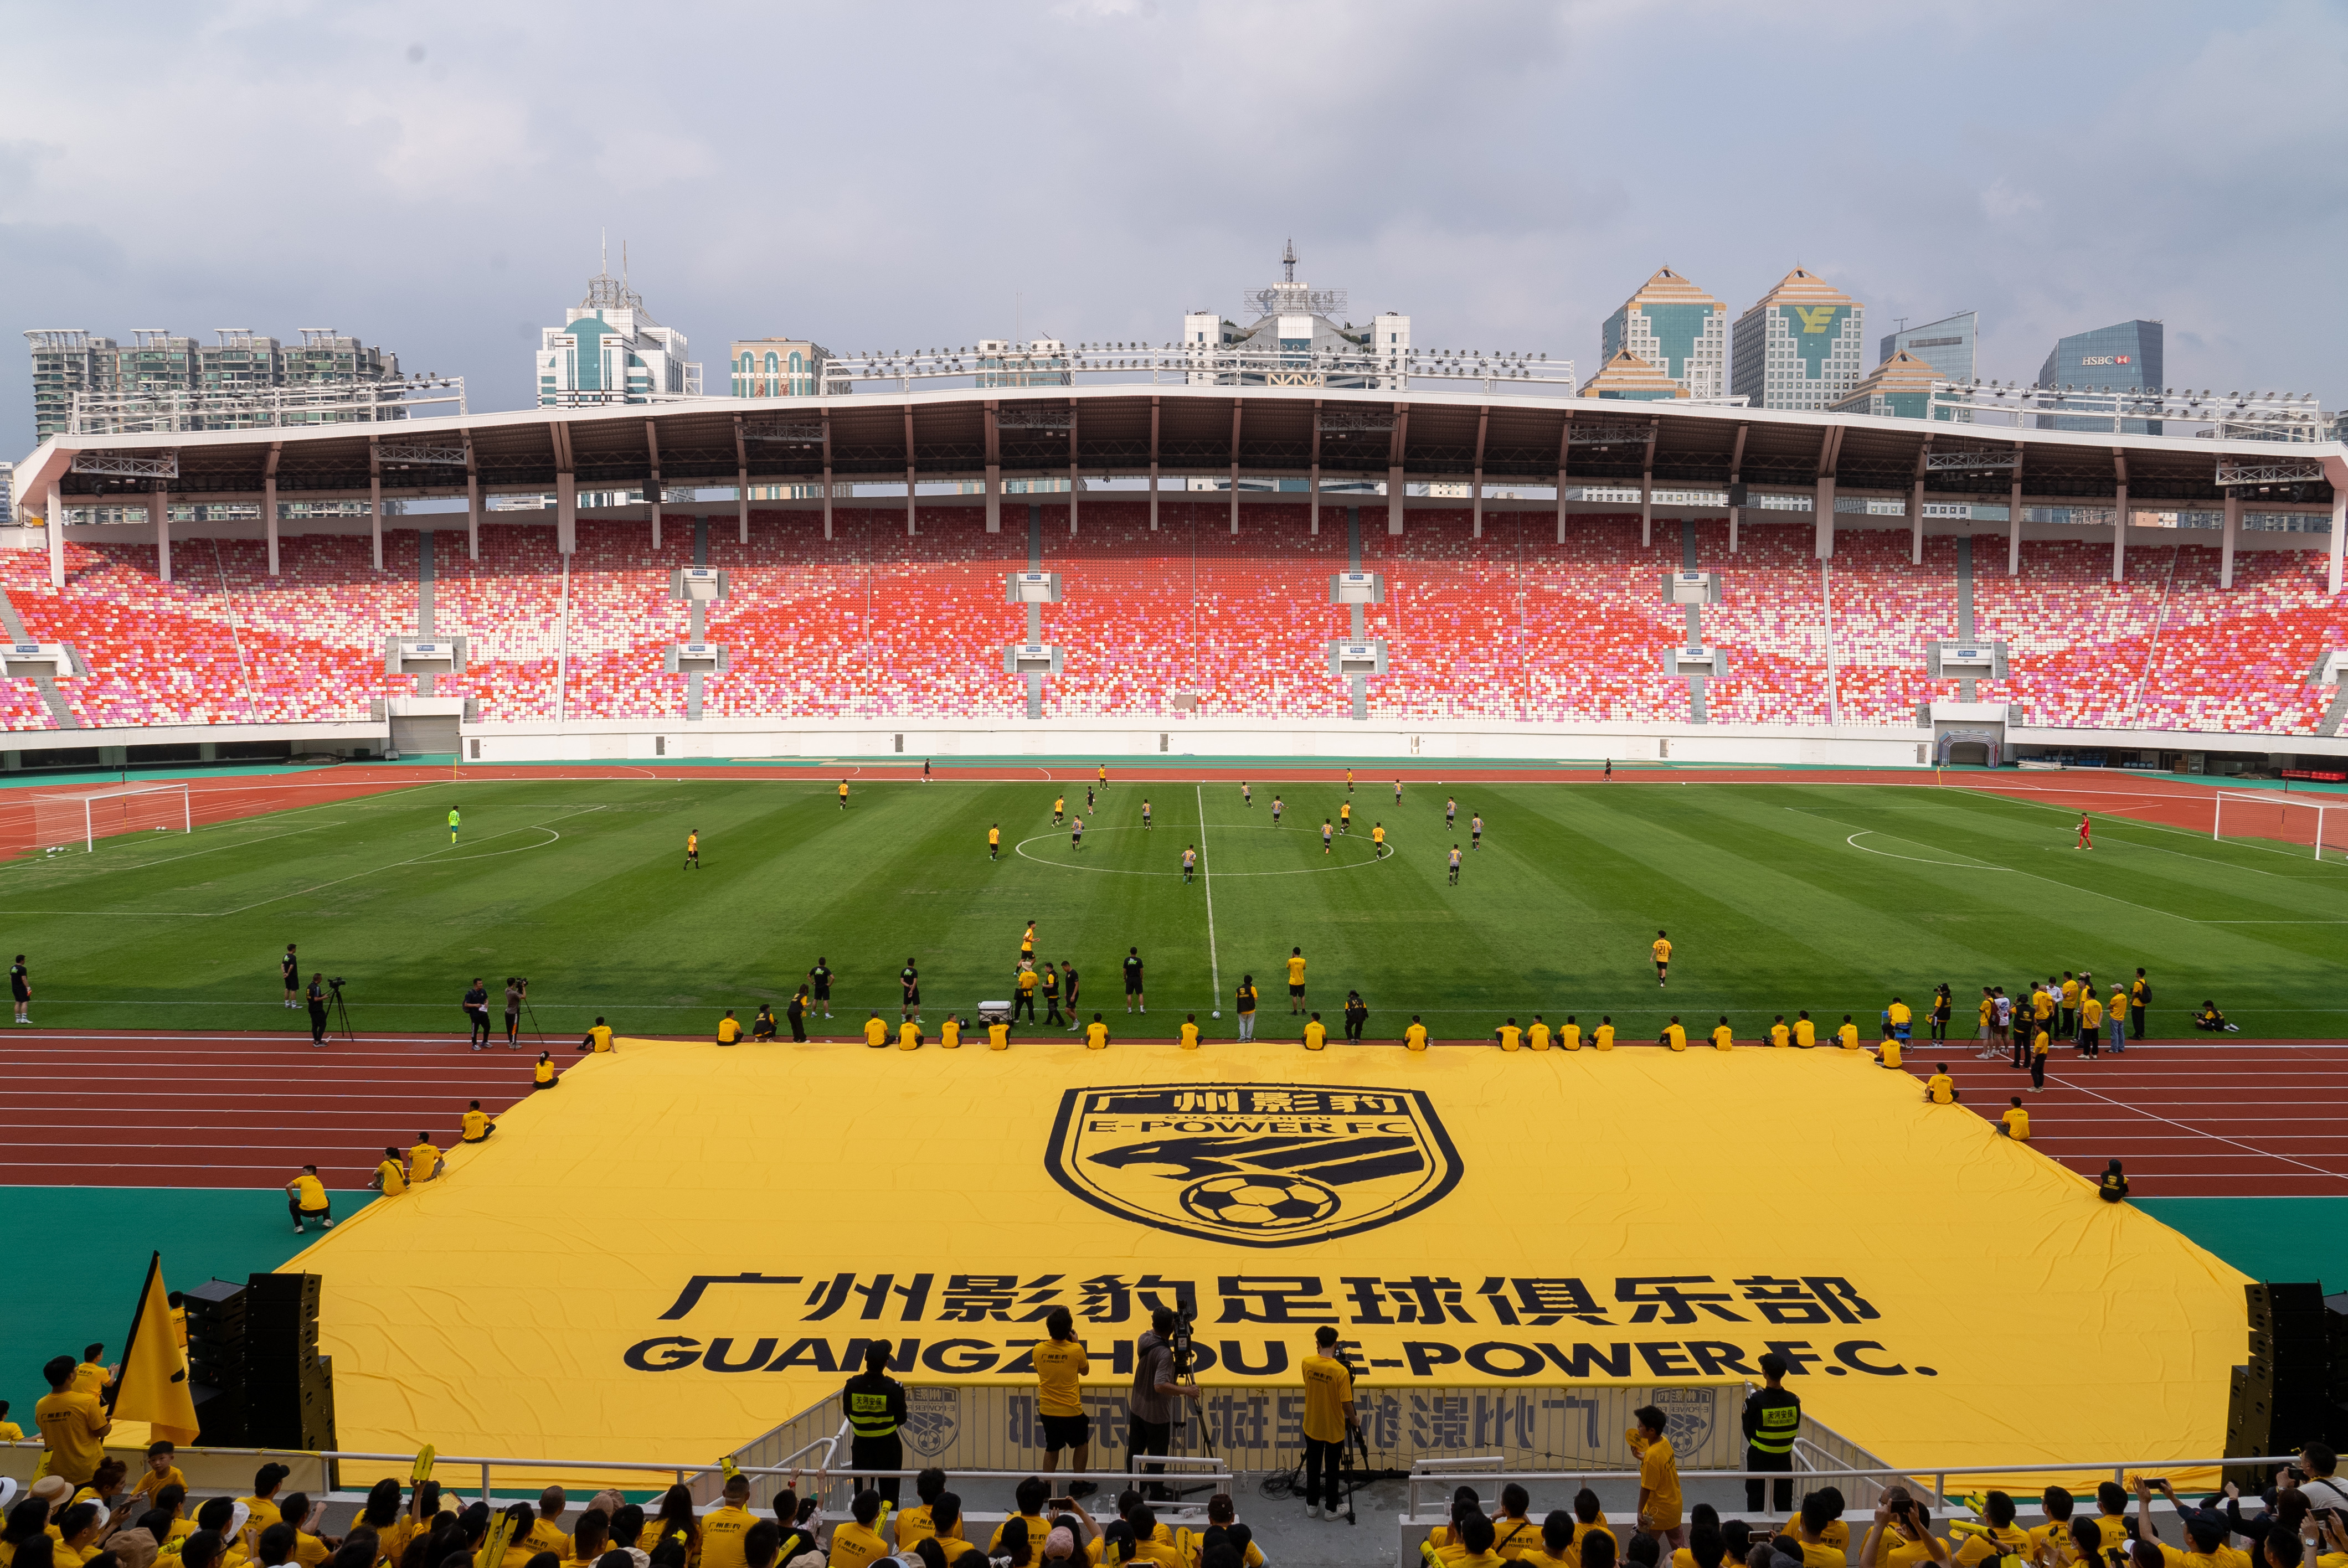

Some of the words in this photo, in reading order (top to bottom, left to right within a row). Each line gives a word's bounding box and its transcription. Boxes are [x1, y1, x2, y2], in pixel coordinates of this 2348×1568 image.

[2082, 355, 2113, 366] HSBC
[1659, 946, 1665, 954] 21
[1093, 1092, 1398, 1112] 广州影豹
[1088, 1120, 1336, 1134] E-POWER
[1350, 1121, 1414, 1134] FC
[657, 1272, 1881, 1323] 广州影豹足球俱乐部
[1763, 1340, 1938, 1376] F.C.
[857, 1396, 882, 1405] 天河安保
[1768, 1410, 1793, 1419] 天河安保
[526, 1538, 548, 1548] 州影豹
[837, 1538, 866, 1554] 广州影豹
